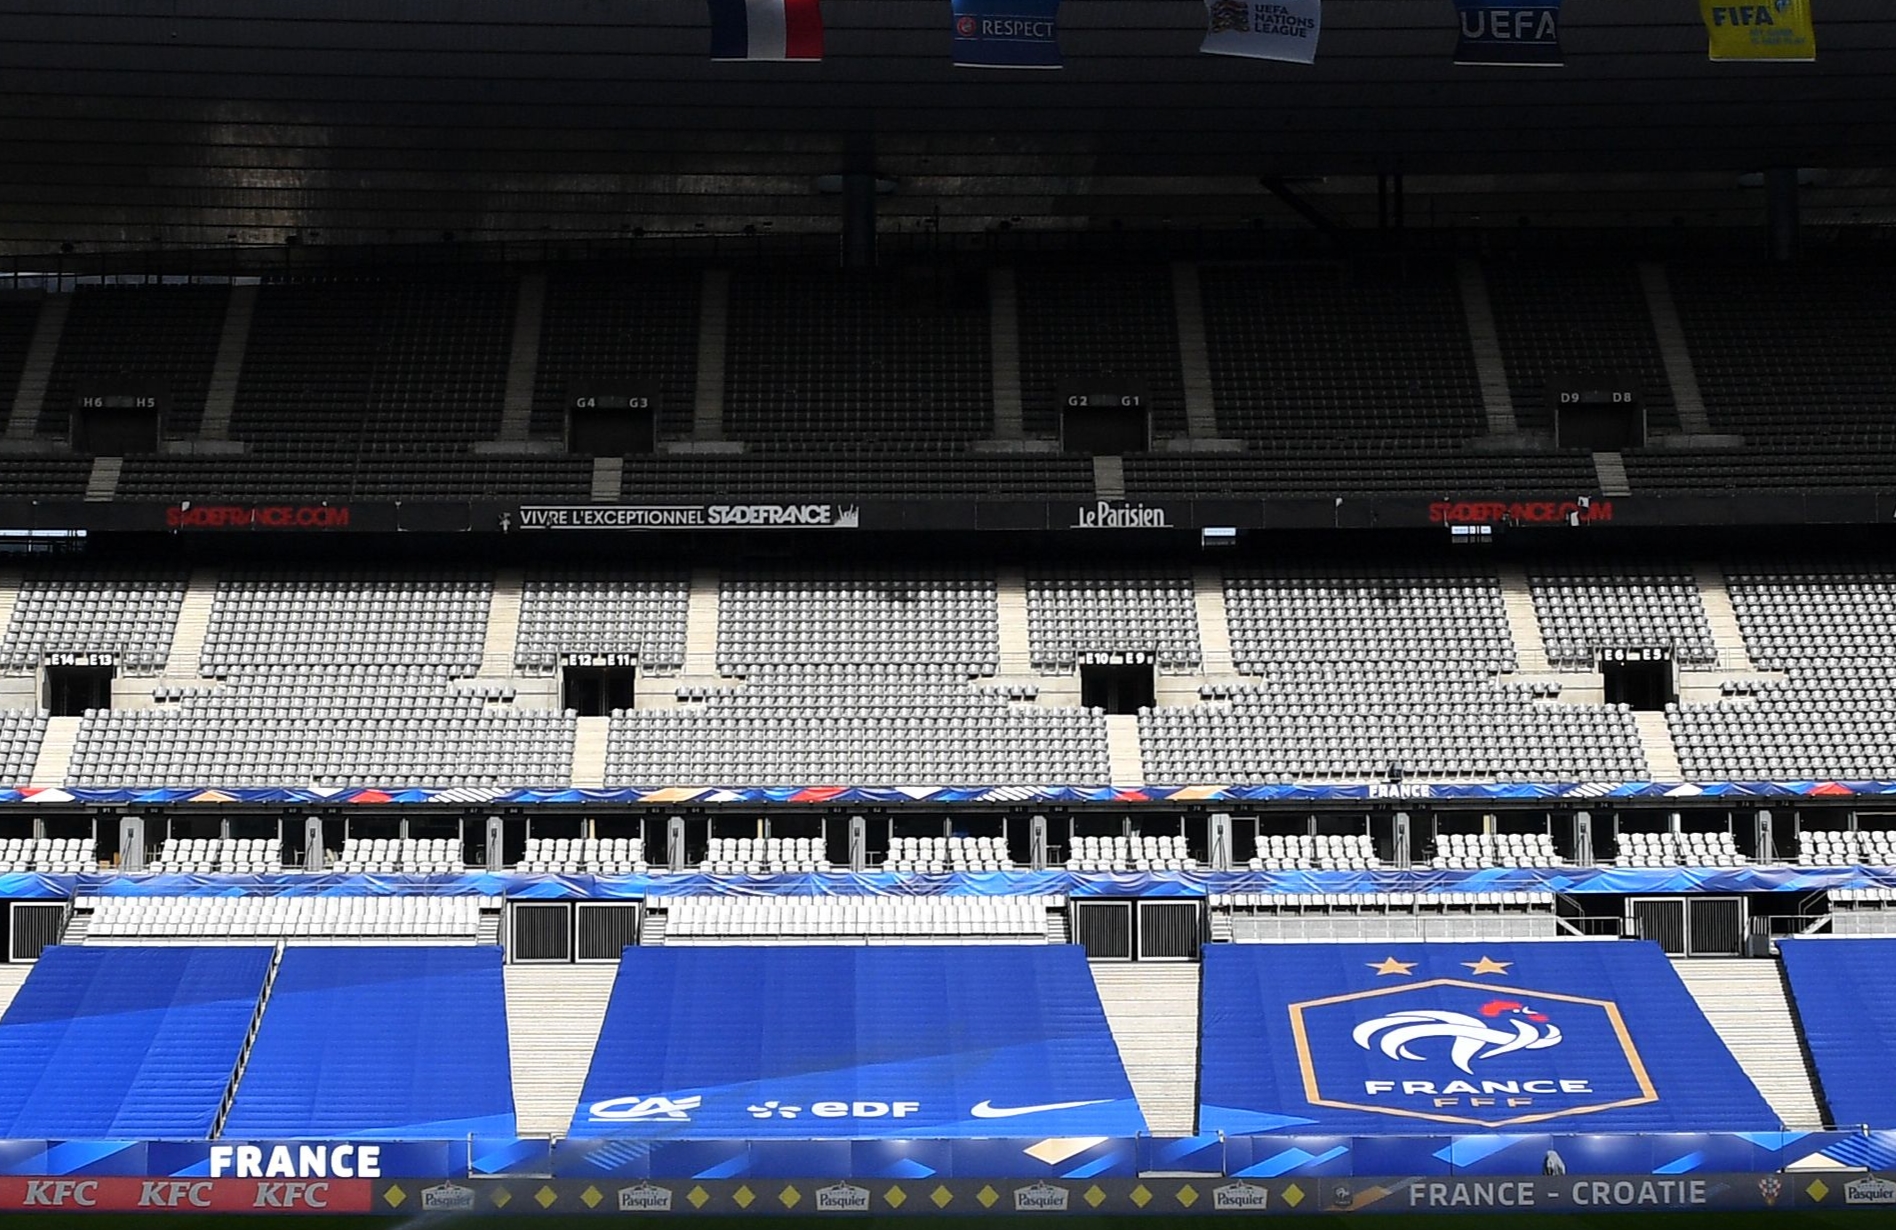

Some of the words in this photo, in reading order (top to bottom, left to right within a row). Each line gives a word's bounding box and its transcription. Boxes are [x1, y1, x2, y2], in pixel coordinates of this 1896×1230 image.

[1254, 4, 1289, 15] UEFA
[1712, 6, 1774, 26] FIFA
[982, 20, 1054, 37] RESPECT
[1254, 13, 1315, 29] NATIONS
[1461, 11, 1556, 39] UEFA
[1254, 23, 1307, 38] LEAGUE
[520, 510, 568, 525] VIVRE
[572, 510, 705, 525] L'EXCEPTIONNEL
[708, 505, 831, 524] STADEFRANCE
[1369, 784, 1430, 798] FRANCE
[1364, 1080, 1593, 1095] FRANCE
[210, 1145, 381, 1178] FRANCE
[23, 1181, 98, 1206] KFC
[138, 1181, 213, 1207] KFC
[253, 1182, 329, 1207] KFC
[622, 1193, 668, 1208] Pasquier
[820, 1193, 866, 1208] Pasquier
[1018, 1193, 1064, 1208] Pasquier
[1217, 1192, 1264, 1207] Pasquier
[1410, 1183, 1535, 1206] FRANCE
[1572, 1181, 1706, 1205] CROATIE
[1848, 1186, 1894, 1201] Pasquier
